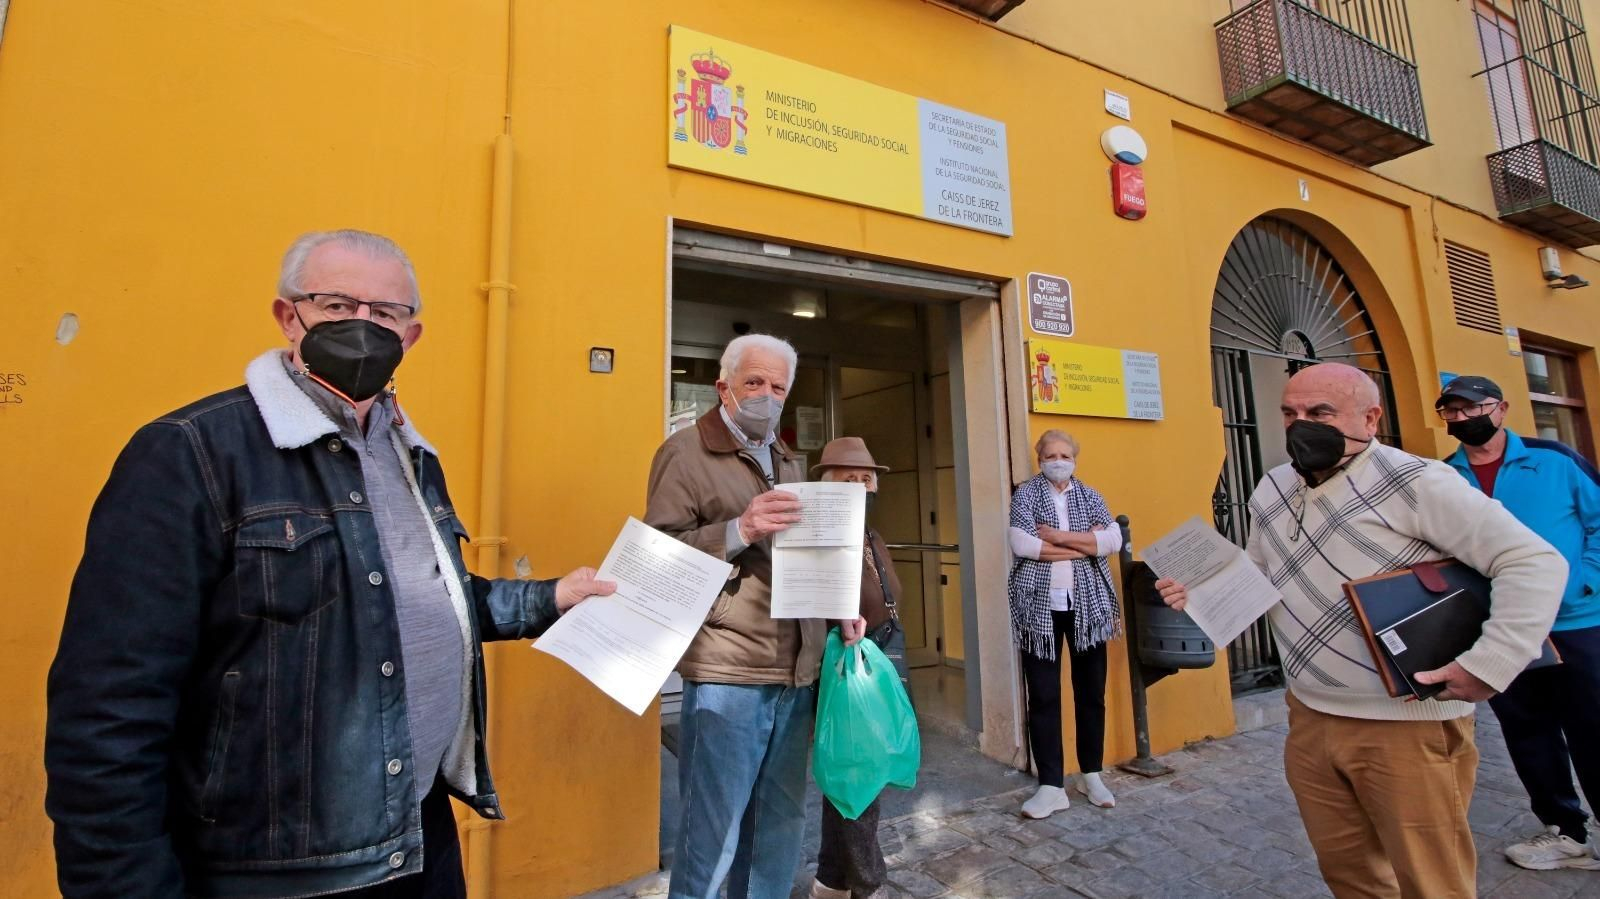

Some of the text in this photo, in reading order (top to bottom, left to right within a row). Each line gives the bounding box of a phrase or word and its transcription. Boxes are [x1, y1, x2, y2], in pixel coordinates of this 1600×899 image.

[766, 90, 816, 113] MINISTERIO
[766, 107, 909, 154] DE INCLUSIÓN, SEGURIDAD SOCIAL
[766, 126, 838, 152] Y MIGRACIONES
[929, 122, 998, 148] DE LA SEGURIDAD SOCIAL
[966, 122, 973, 130] DE
[975, 124, 996, 137] ESTADO
[953, 140, 984, 155] PENSIONES
[940, 157, 999, 178] INSTITUTO NACIONAL
[936, 167, 943, 176] DE
[953, 172, 985, 186] SEGURIDAD
[986, 180, 1006, 192] SOCIAL
[942, 189, 1000, 212] CAISS DE JEREZ
[1124, 194, 1145, 206] FUEGO
[938, 204, 1003, 228] DE LA FRONTERA
[1035, 319, 1069, 333] 900 920 920
